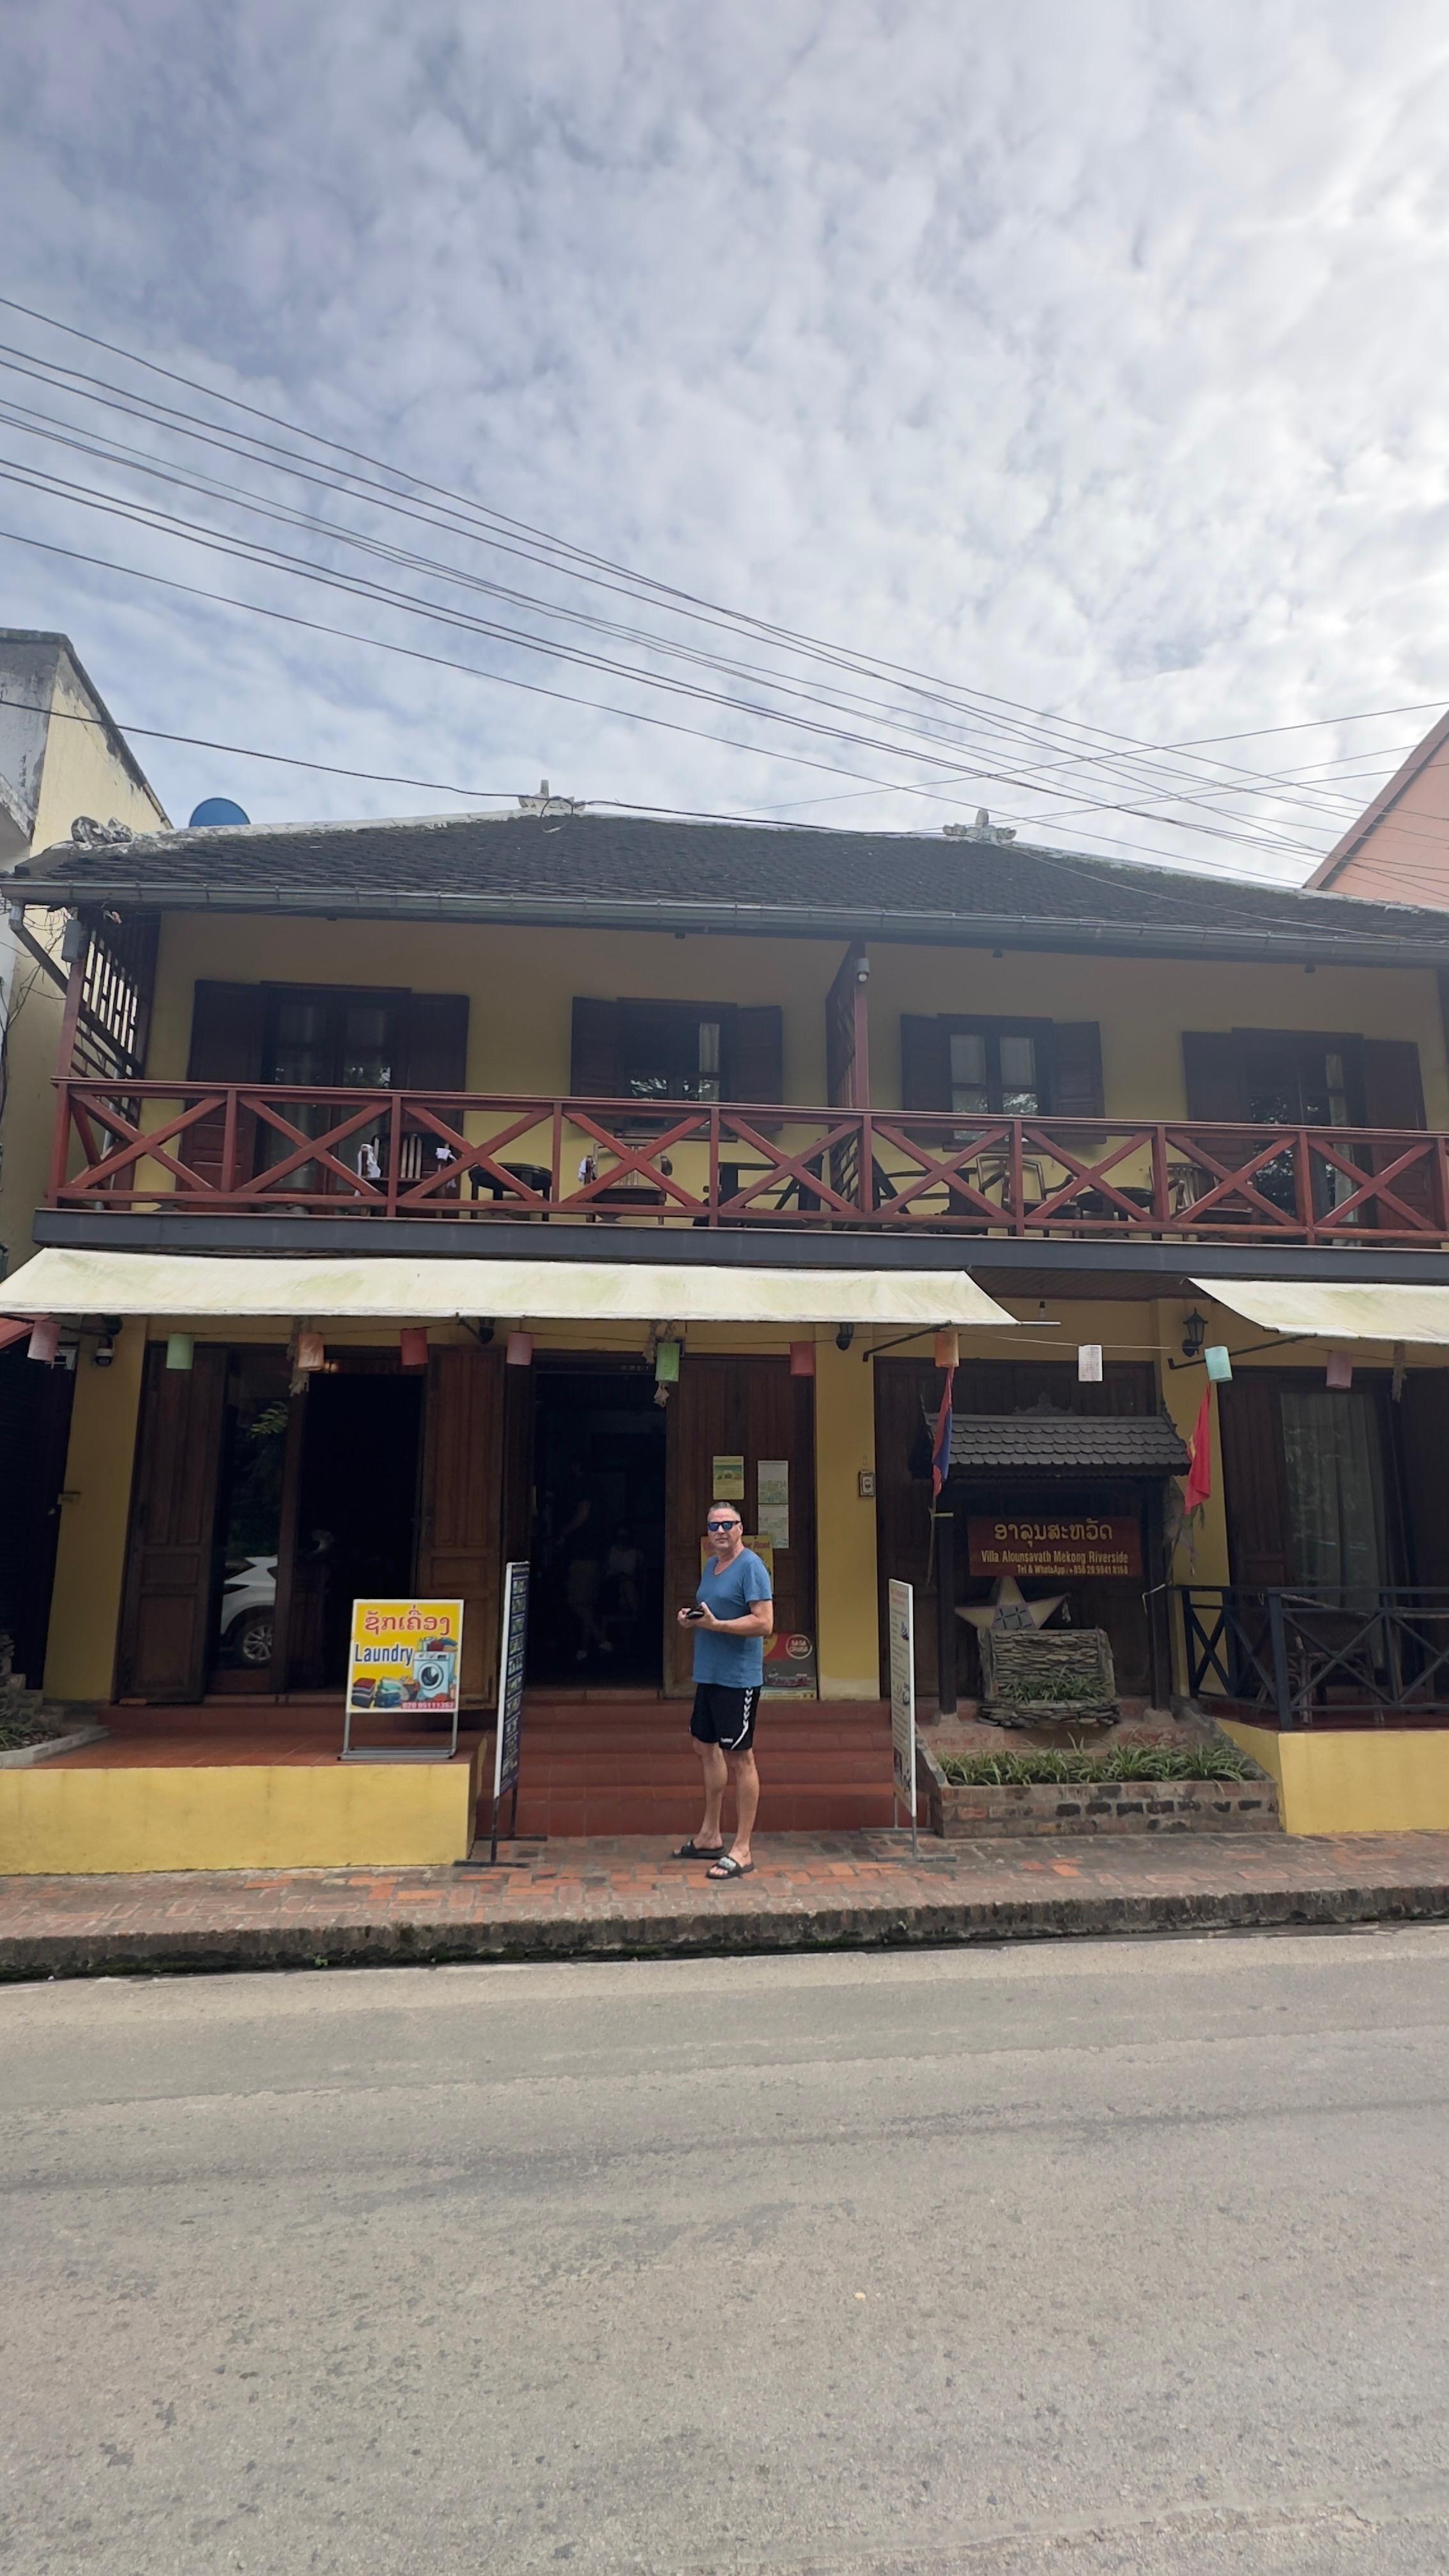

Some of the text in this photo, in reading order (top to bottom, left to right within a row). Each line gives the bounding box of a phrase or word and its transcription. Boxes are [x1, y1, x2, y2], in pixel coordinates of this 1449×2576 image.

[981, 1550, 1128, 1565] Villa Alounsavath Mekong Riverside
[1017, 1565, 1027, 1574] Tel
[1028, 1565, 1033, 1574] &
[365, 1604, 451, 1636] ຊັກເຄື່ອງ
[355, 1643, 413, 1666] Laundry
